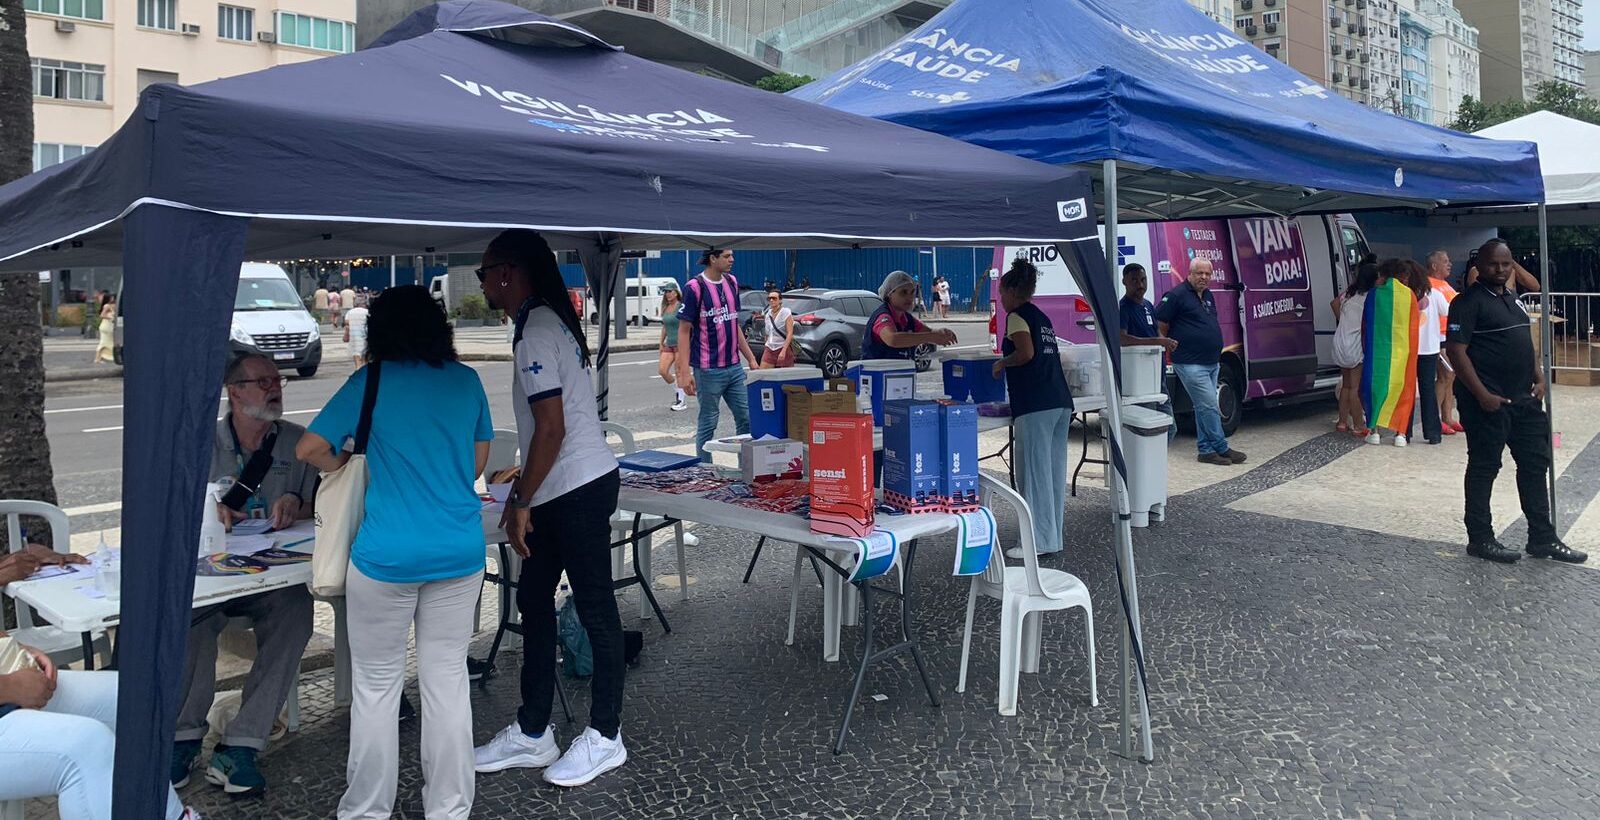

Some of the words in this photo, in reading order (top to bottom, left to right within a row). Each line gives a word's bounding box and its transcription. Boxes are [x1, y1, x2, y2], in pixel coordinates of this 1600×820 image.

[441, 74, 733, 126] VIGILÂNCIA
[1245, 218, 1292, 255] VAN
[1029, 245, 1058, 263] RIO
[1265, 257, 1303, 285] BORA!
[814, 469, 846, 479] sensi
[914, 453, 922, 474] tex
[952, 453, 960, 474] tex
